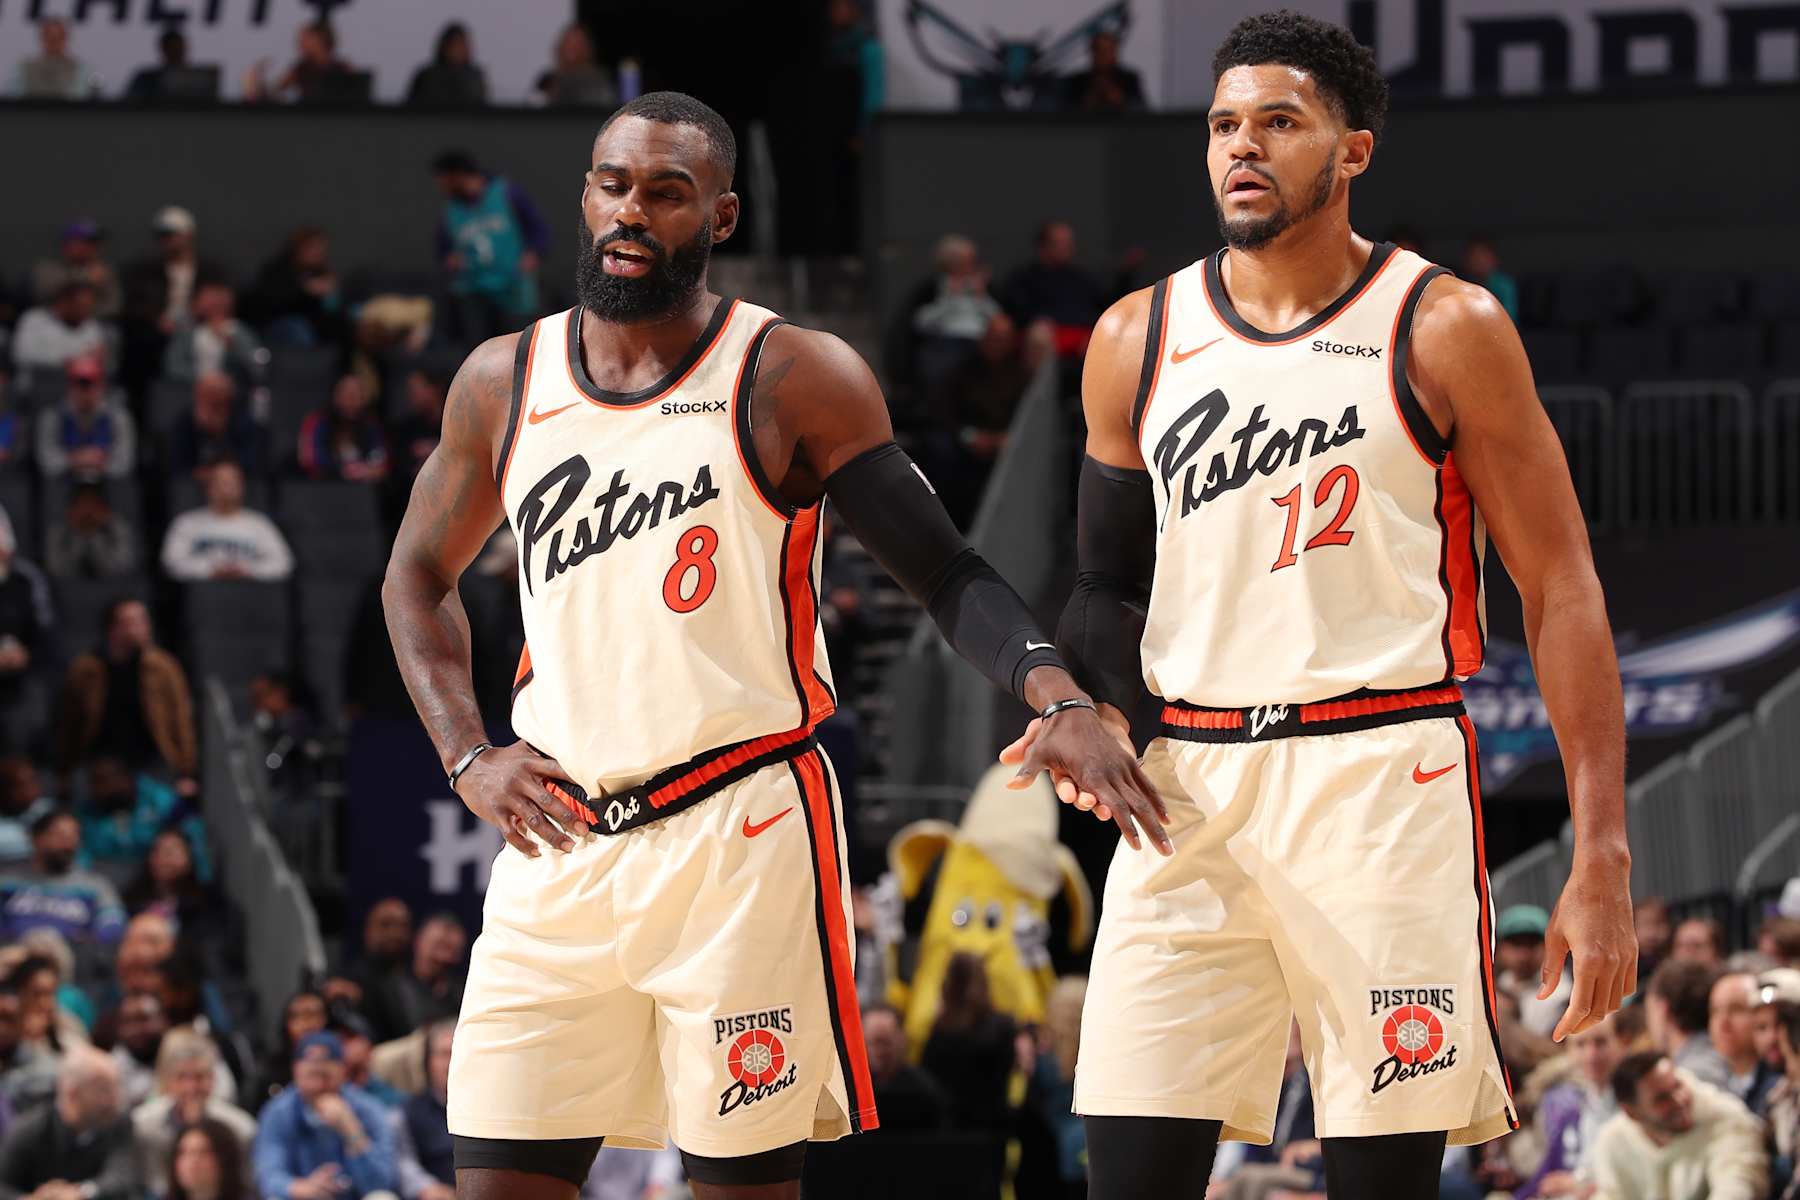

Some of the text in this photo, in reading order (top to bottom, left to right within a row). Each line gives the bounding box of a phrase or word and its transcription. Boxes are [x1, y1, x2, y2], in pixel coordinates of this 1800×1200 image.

[1311, 340, 1383, 360] StockX
[660, 400, 728, 416] StockX
[1153, 388, 1367, 534] Pistons
[516, 453, 721, 598] Pistons
[1269, 463, 1361, 574] 12
[661, 524, 720, 614] 8
[1249, 704, 1290, 739] Det
[603, 795, 641, 832] Det
[1369, 988, 1455, 1016] PISTONS
[714, 1008, 792, 1044] PISTONS
[718, 1063, 797, 1116] Detroit
[1371, 1045, 1457, 1094] Detroit
